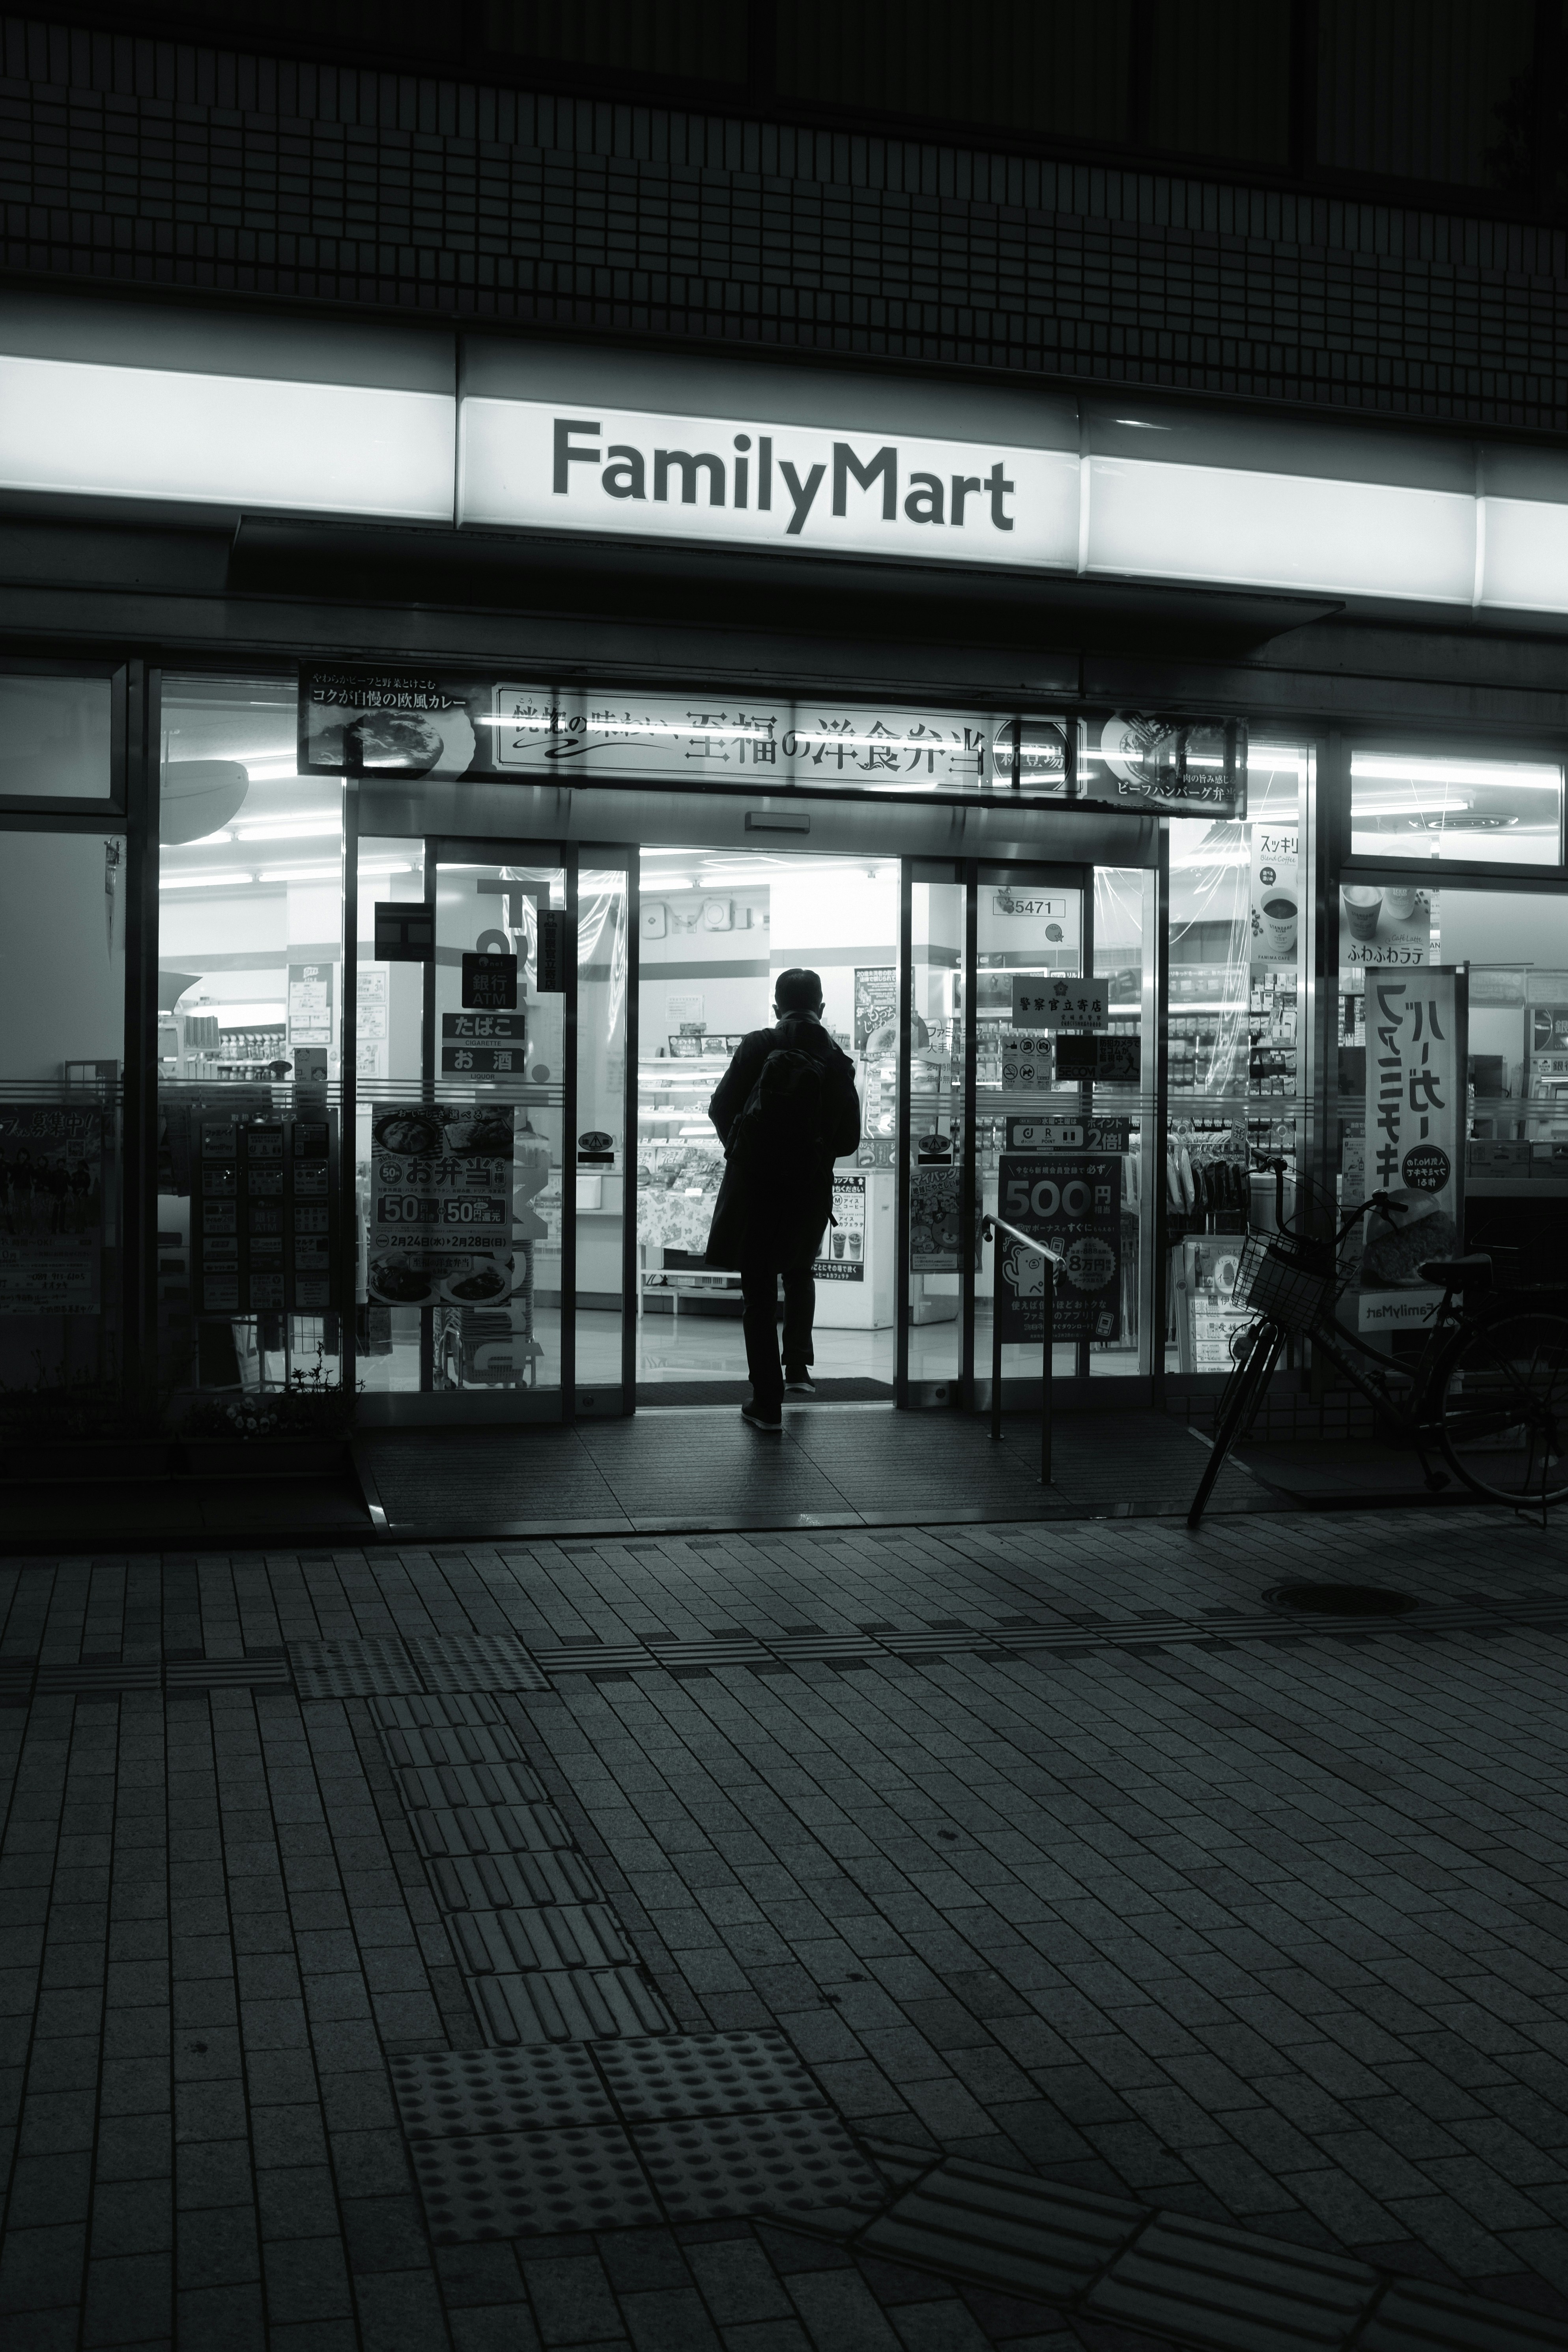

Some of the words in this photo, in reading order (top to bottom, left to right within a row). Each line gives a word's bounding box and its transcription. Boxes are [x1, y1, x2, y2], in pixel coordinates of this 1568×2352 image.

[553, 418, 1016, 536] FamilyMart
[313, 689, 467, 710] コクが自慢の欧風カレー
[684, 711, 985, 776] 至福の洋食弁当
[1183, 774, 1236, 784] 肉の旨み感じる
[1118, 782, 1236, 802] ビーフハンバーグ弁当
[1277, 856, 1295, 865] Coffee
[1347, 945, 1424, 965] ふわふわラテ
[472, 974, 507, 991] 銀行
[472, 993, 506, 1005] ATM
[1019, 997, 1102, 1012] 警察官立寄店
[455, 1016, 512, 1036] たばこ
[1099, 1039, 1140, 1048] 防犯カメラで
[1099, 1054, 1123, 1062] 監視中
[1058, 1066, 1095, 1077] SECOM
[398, 1109, 490, 1120] おいしさ選べる。
[1088, 1119, 1123, 1129] ポイント
[1086, 1129, 1122, 1150] 2倍!
[205, 1144, 233, 1152] FamiPay
[406, 1157, 492, 1187] お弁当
[1005, 1180, 1091, 1217] 500
[1095, 1185, 1111, 1204] 円
[385, 1196, 418, 1222] 50
[420, 1204, 428, 1212] 円
[447, 1202, 473, 1222] 50
[1094, 1206, 1110, 1214] 相当
[255, 1212, 277, 1223] 銀行
[482, 1212, 501, 1222] 還元
[391, 1235, 445, 1247] 2月24日(水)
[452, 1236, 506, 1247] 2月28日(日)
[413, 1258, 469, 1268] 至福の洋食弁当
[811, 1264, 856, 1273] ごとにその場で挽く
[1069, 1255, 1105, 1271] 8万円
[1011, 1300, 1106, 1311] 使えば使ほどおトクな
[1023, 1311, 1094, 1321] ファミのアプリ!
